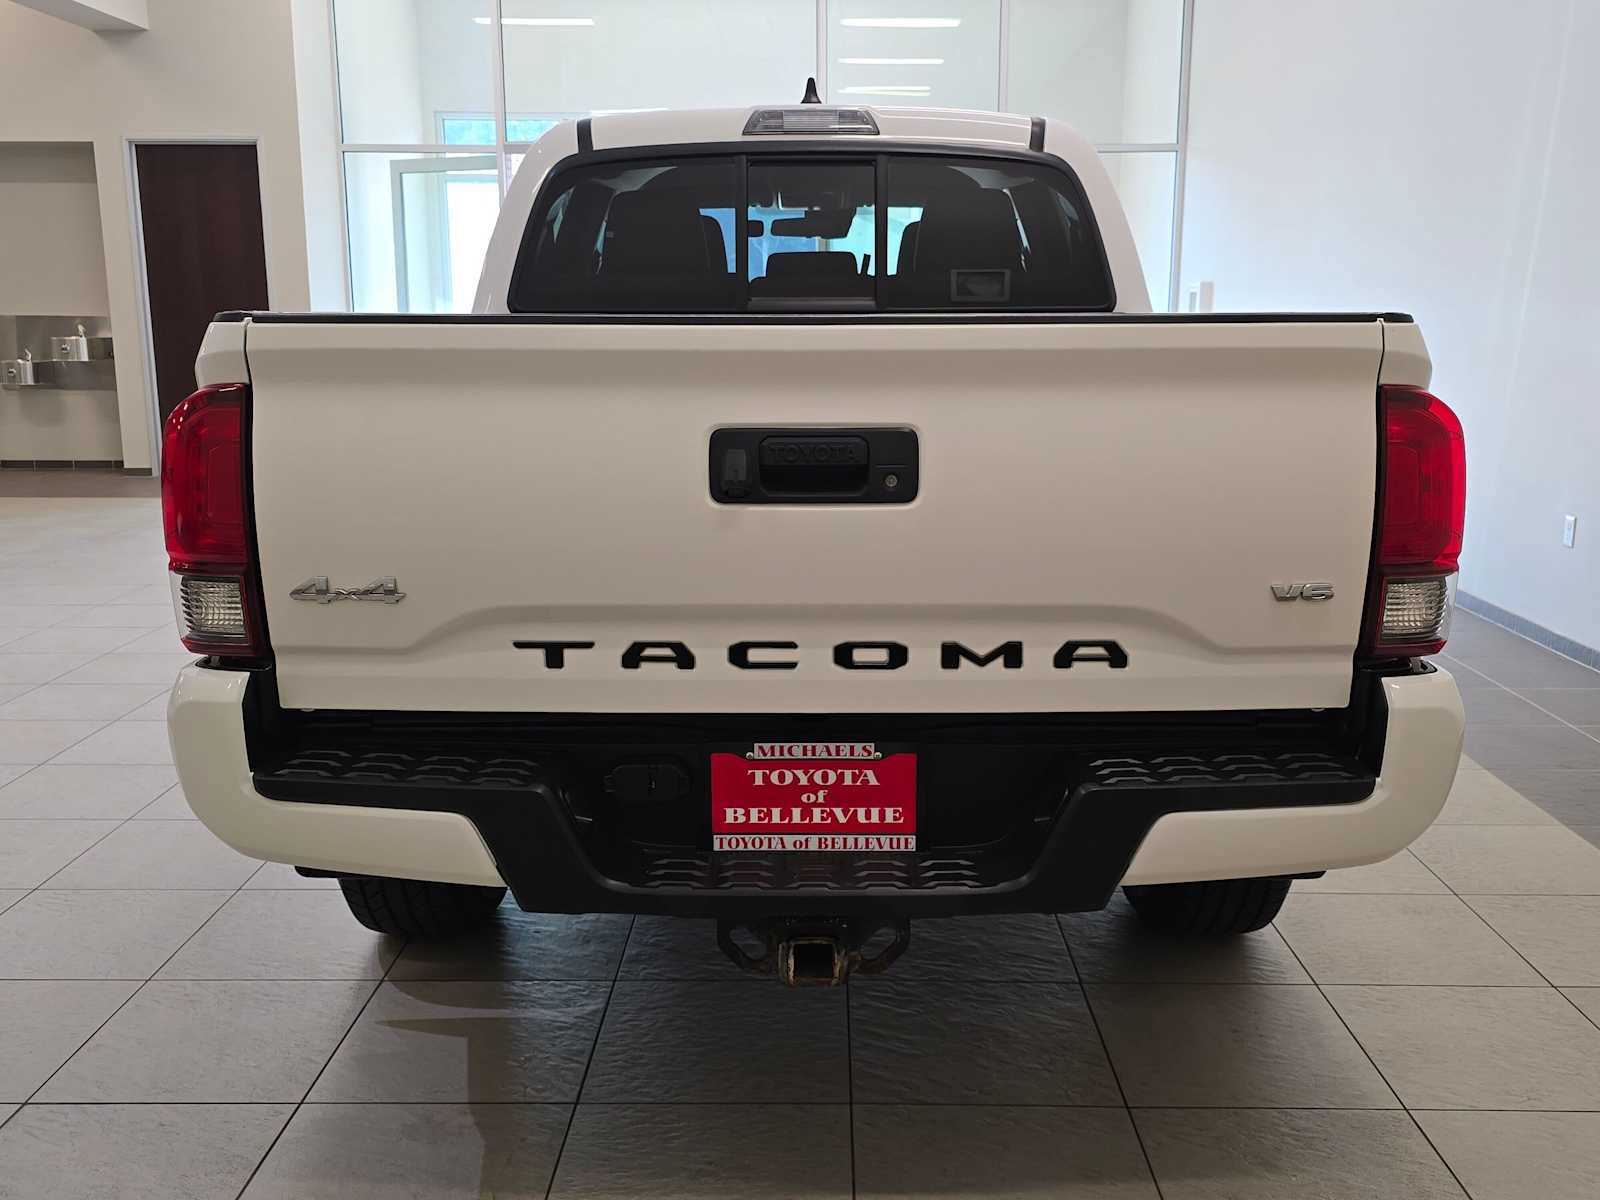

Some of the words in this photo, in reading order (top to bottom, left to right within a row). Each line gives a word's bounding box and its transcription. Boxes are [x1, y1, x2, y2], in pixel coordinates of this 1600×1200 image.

[768, 443, 857, 461] TOYOTA
[1271, 583, 1334, 602] V6
[512, 640, 1128, 670] TACOMA
[757, 744, 874, 758] MICHAELS
[747, 769, 880, 786] TOYOTA
[801, 790, 828, 803] of
[724, 807, 904, 824] BELLEVUE
[715, 837, 787, 850] TOYOTA
[793, 836, 811, 850] of
[818, 837, 914, 850] BELLEVUE
